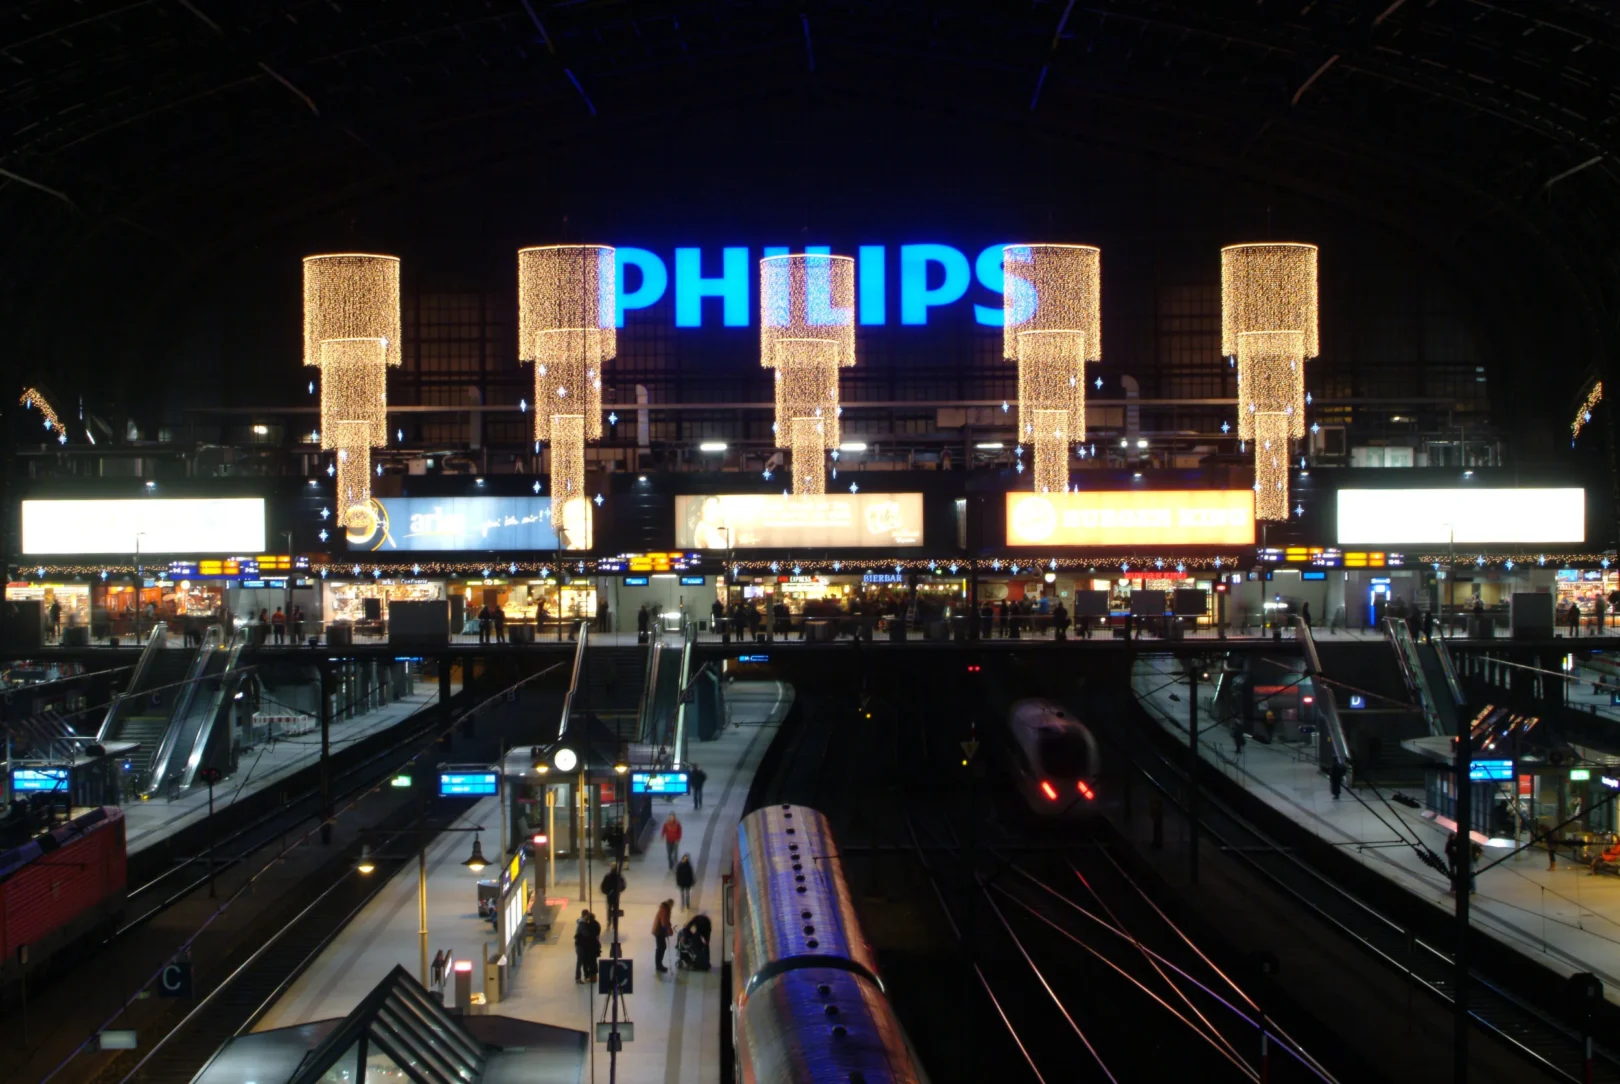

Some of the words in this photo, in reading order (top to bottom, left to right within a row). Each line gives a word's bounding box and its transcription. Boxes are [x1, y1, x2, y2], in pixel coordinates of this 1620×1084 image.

[598, 243, 1038, 328] PHILIPS
[1064, 510, 1171, 527] BURGER
[1179, 509, 1247, 527] KING
[162, 965, 181, 990] C
[609, 961, 628, 988] C
